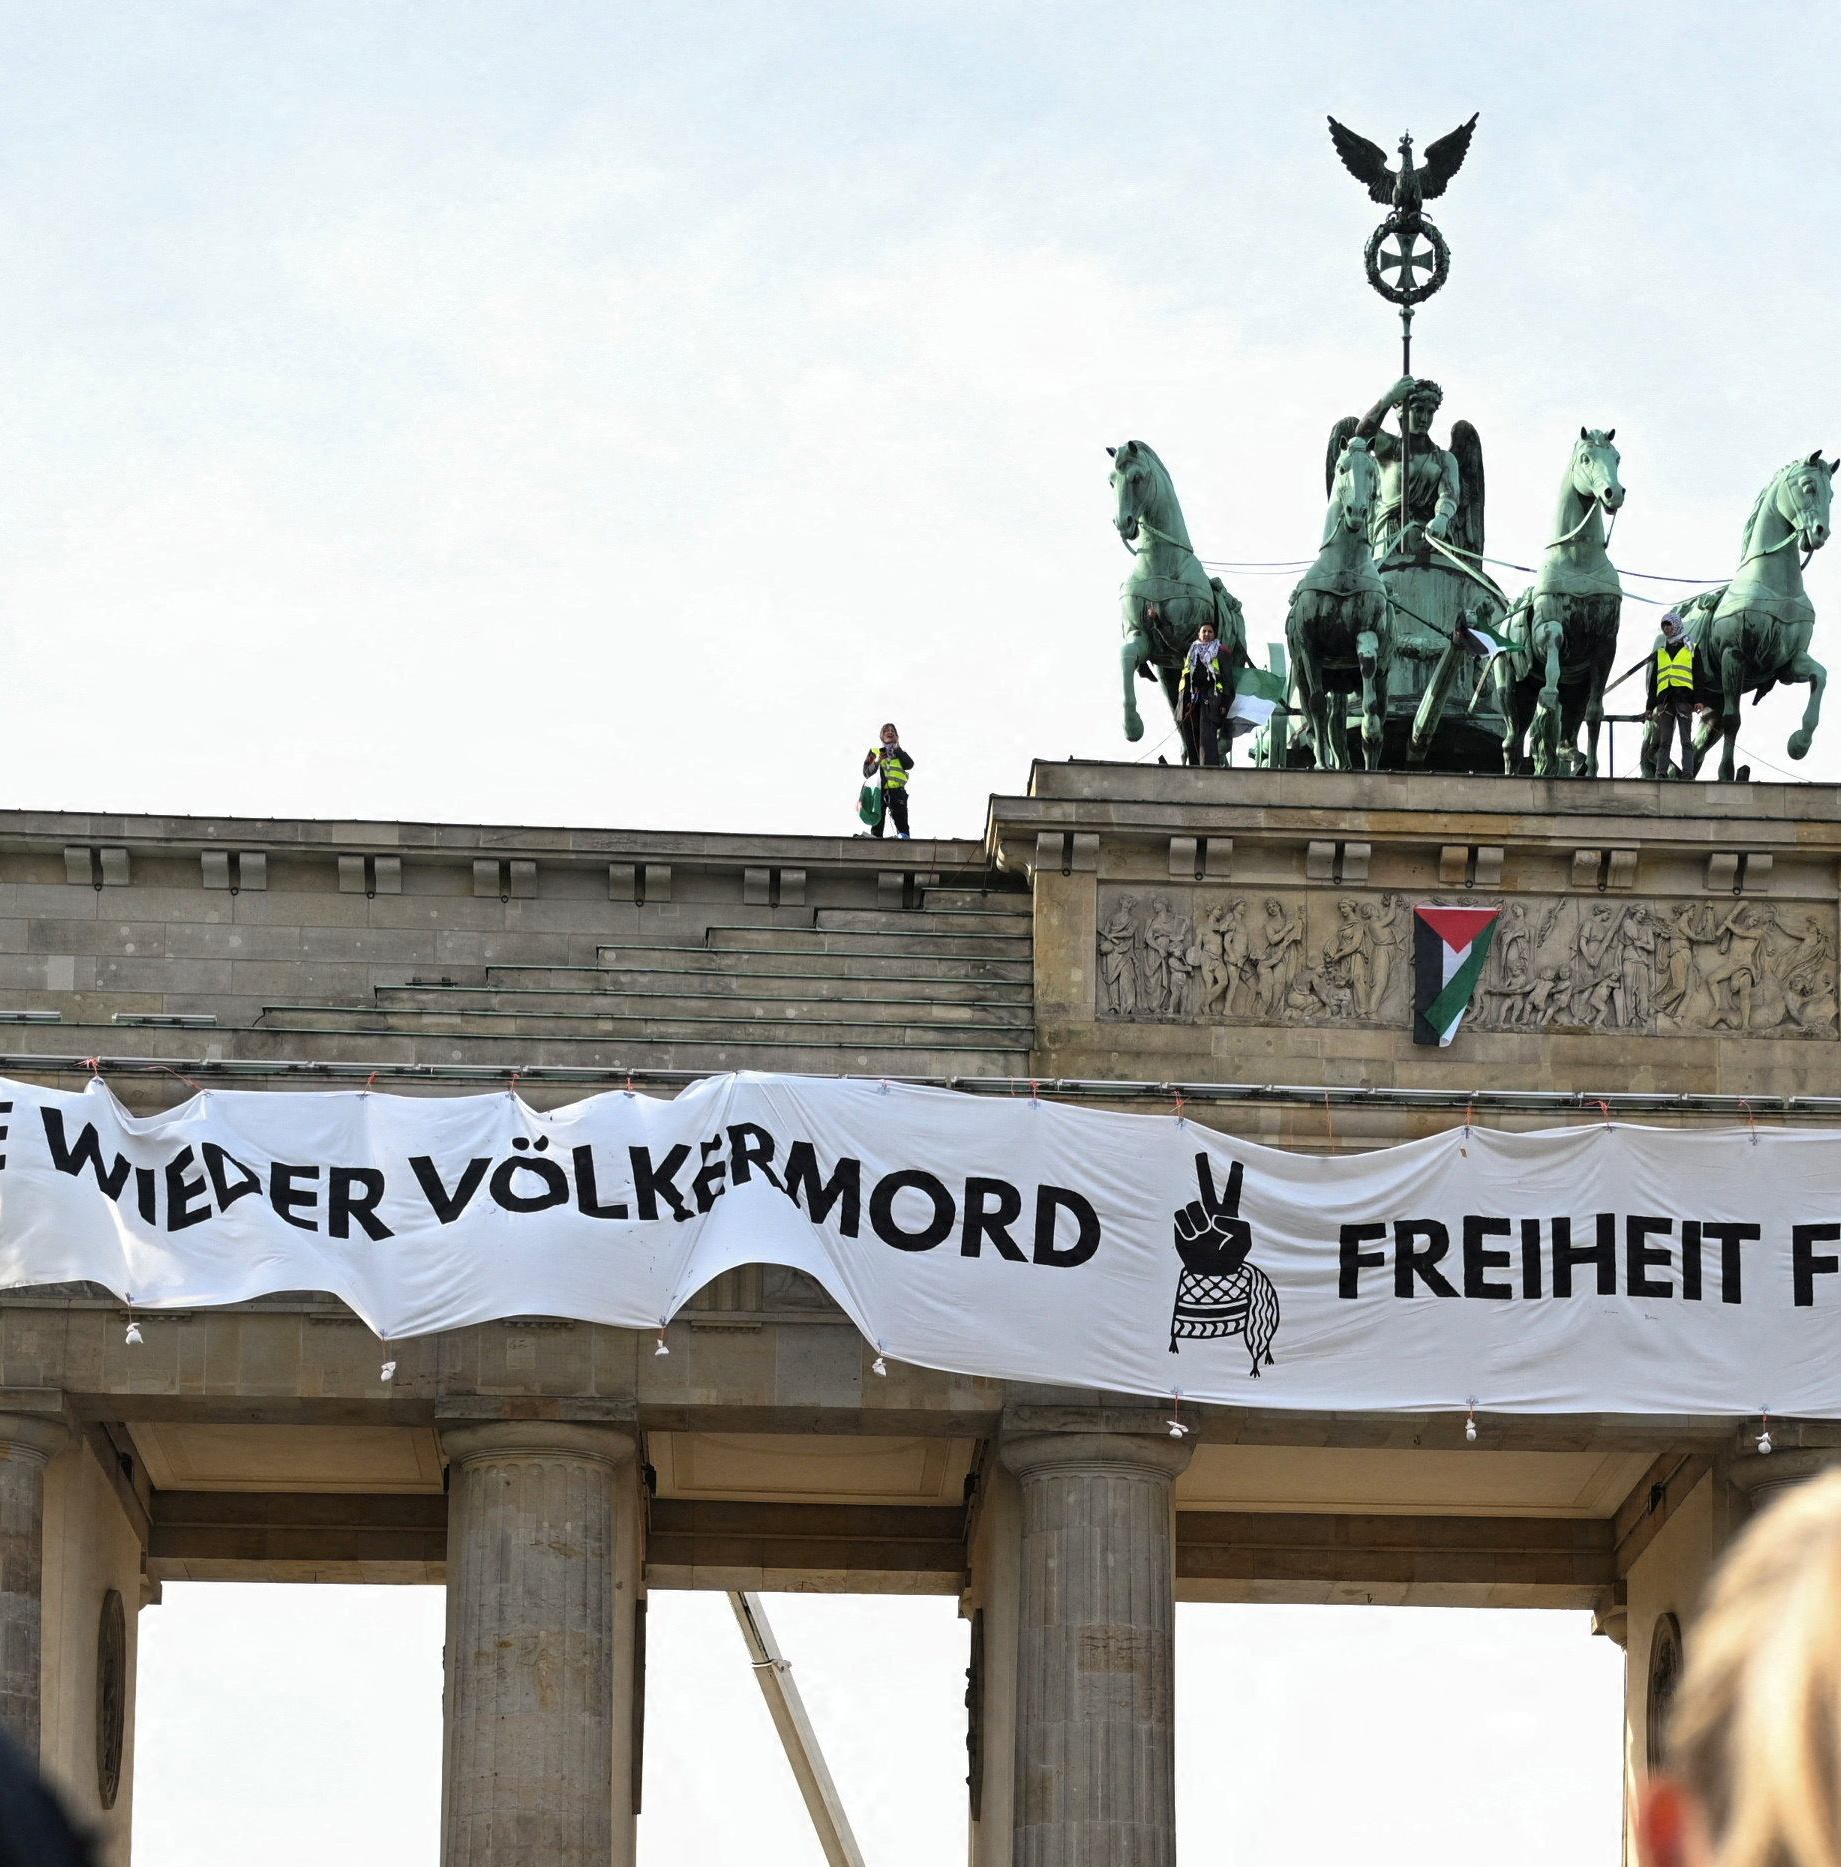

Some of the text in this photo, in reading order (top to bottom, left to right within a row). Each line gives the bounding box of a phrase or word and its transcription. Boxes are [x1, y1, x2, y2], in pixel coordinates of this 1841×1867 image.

[39, 1104, 397, 1243] WIEDER
[407, 1121, 1103, 1270] VÖLKERMORD
[1337, 1211, 1762, 1307] FREIHEIT
